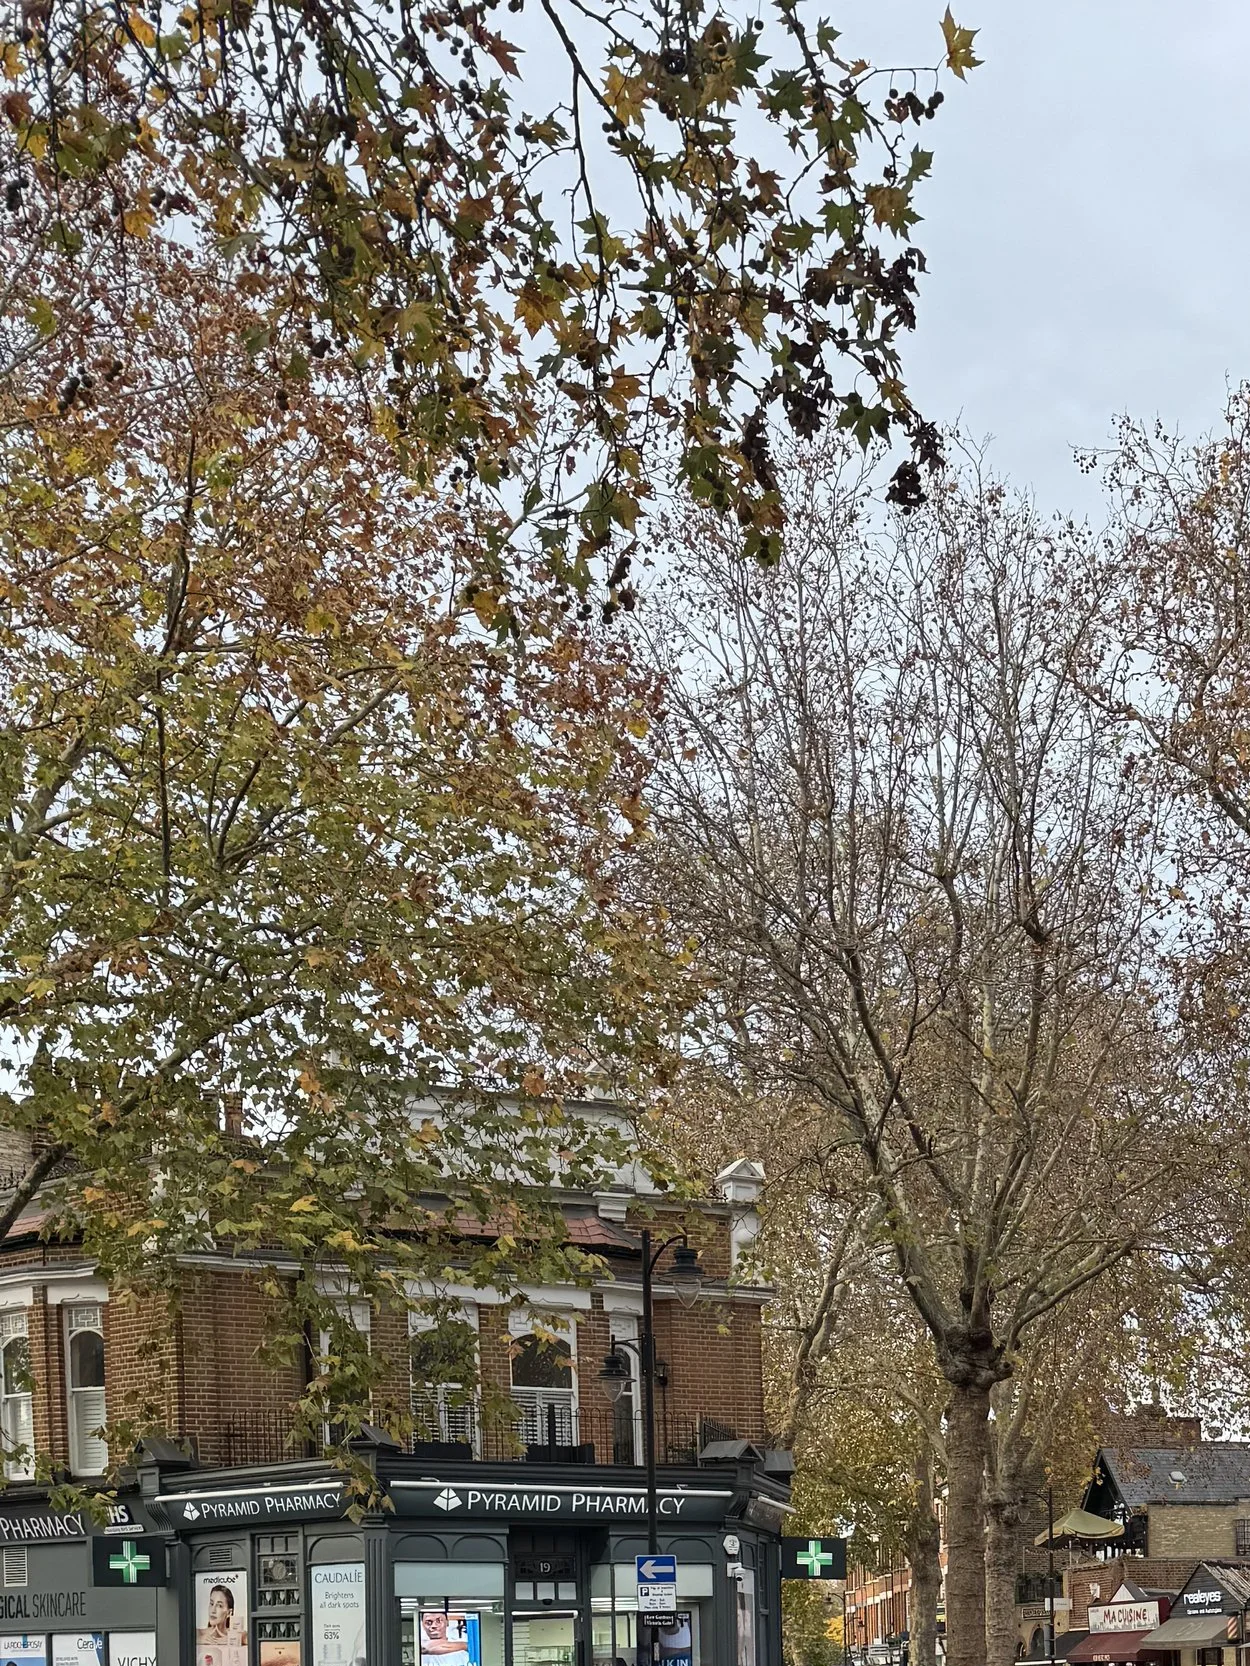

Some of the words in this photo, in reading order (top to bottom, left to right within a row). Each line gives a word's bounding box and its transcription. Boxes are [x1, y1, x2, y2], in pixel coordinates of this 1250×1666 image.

[201, 1501, 260, 1519] PYRAMID
[264, 1493, 340, 1513] PHARMACY
[467, 1491, 561, 1512] PYRAMID
[0, 1514, 85, 1540] PHARMACY
[540, 1562, 551, 1573] 19
[32, 1592, 87, 1618] SKINCARE
[343, 1602, 359, 1610] spots
[1183, 1589, 1222, 1606] realeyes
[77, 1638, 102, 1649] CeraVe
[324, 1631, 340, 1640] 63%
